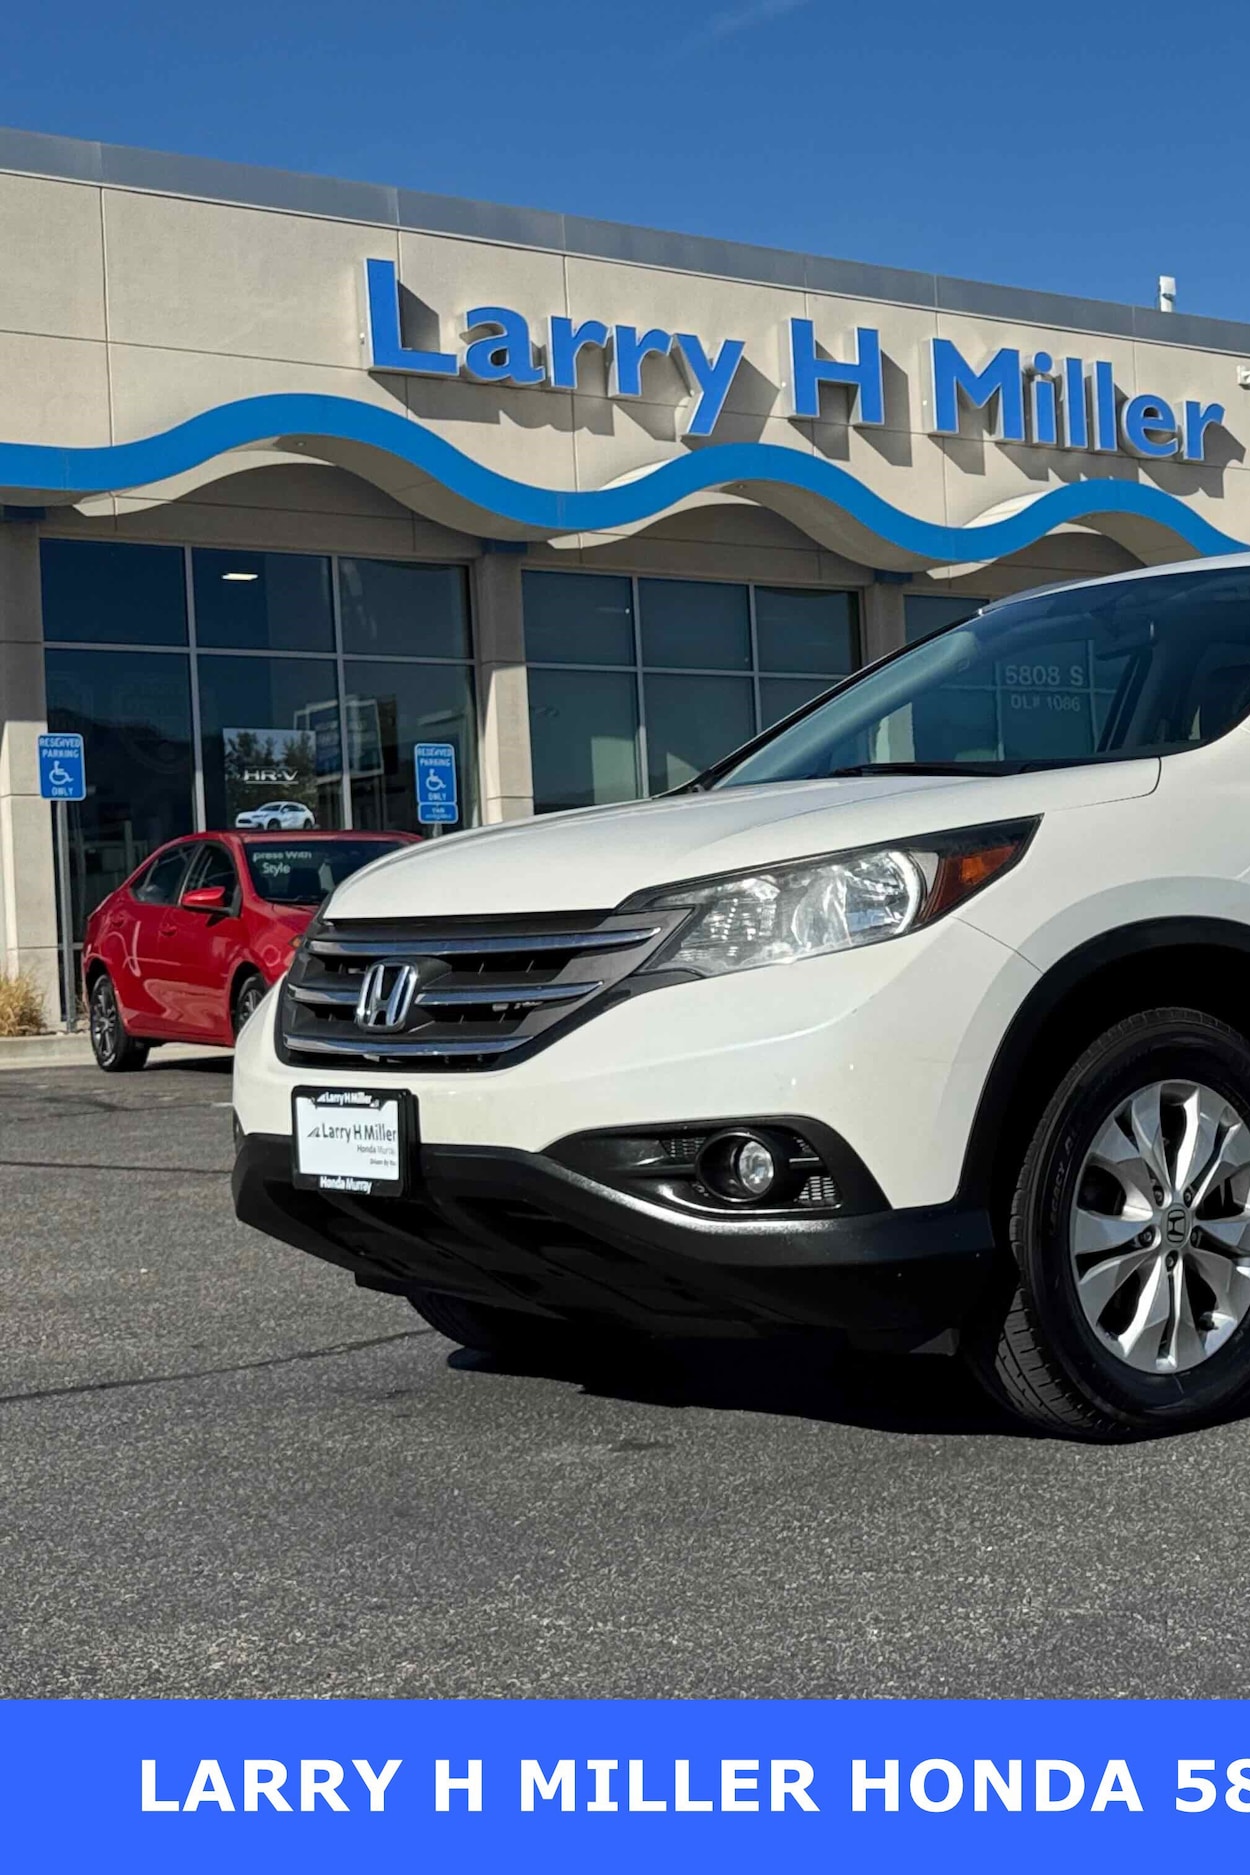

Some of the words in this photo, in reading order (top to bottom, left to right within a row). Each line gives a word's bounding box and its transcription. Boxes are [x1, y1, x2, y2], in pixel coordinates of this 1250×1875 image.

[364, 257, 746, 436] Larry
[788, 317, 885, 426] H
[926, 337, 1226, 461] Miller
[1005, 665, 1061, 686] 5808
[1071, 665, 1084, 686] S
[39, 738, 80, 748] RESERVED
[42, 749, 79, 758] PARKING
[52, 787, 73, 796] ONLY
[262, 862, 291, 877] Style
[326, 1092, 344, 1106] Larry
[351, 1092, 372, 1105] Miller
[322, 1122, 352, 1144] Larry
[353, 1124, 362, 1141] H
[364, 1123, 397, 1142] Miller
[357, 1145, 376, 1154] Honda
[320, 1176, 345, 1191] Honda
[346, 1178, 373, 1195] Murray
